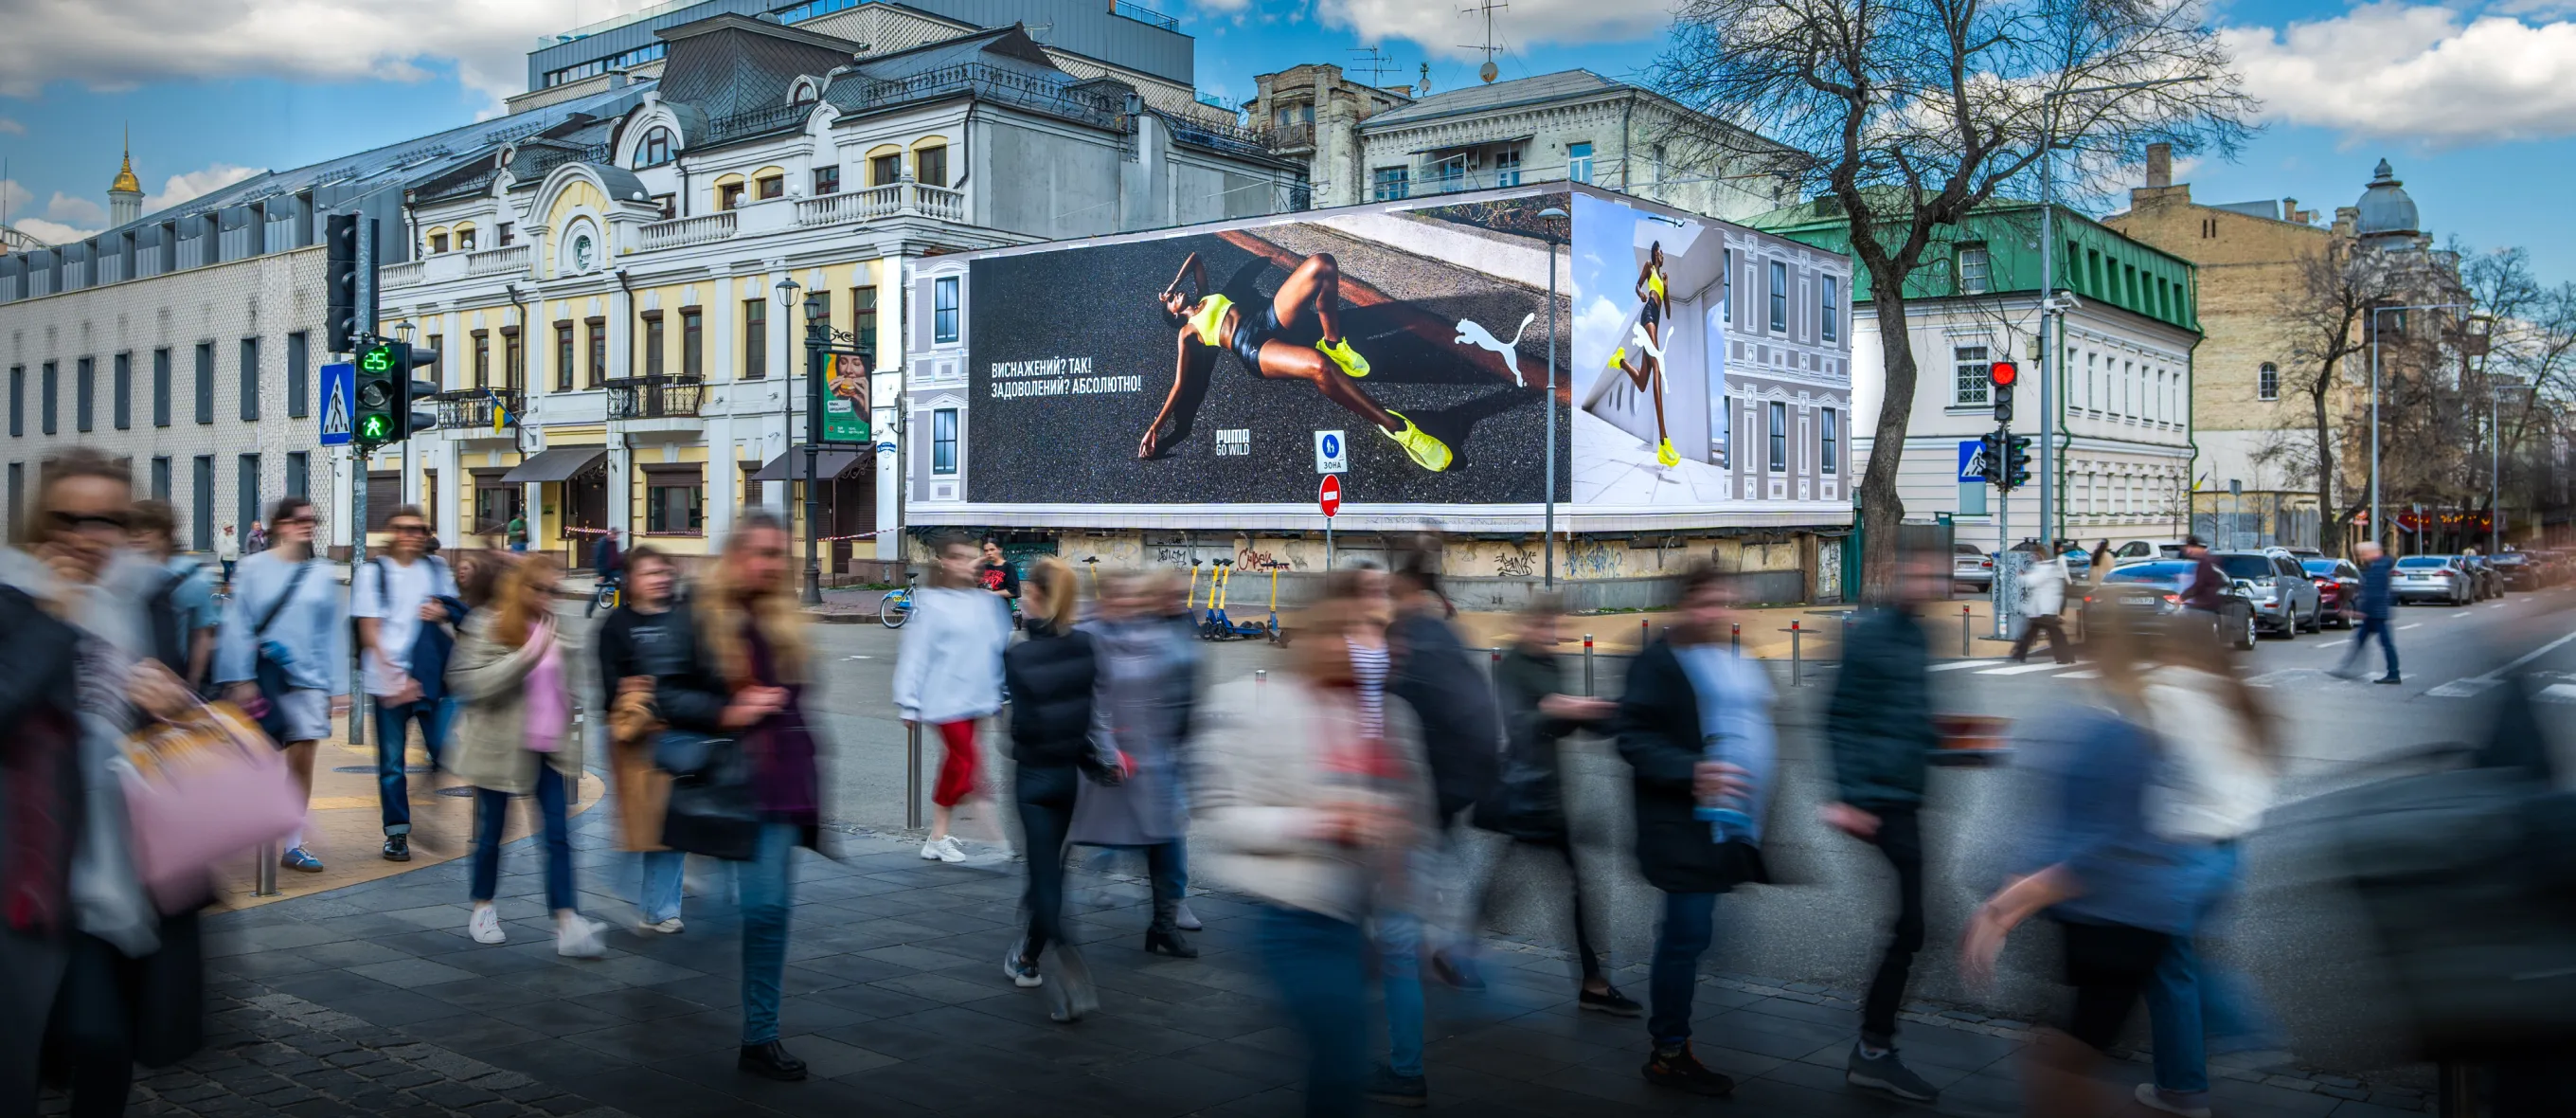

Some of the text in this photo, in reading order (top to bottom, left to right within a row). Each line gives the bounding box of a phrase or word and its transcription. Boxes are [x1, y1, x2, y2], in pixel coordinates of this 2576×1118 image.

[365, 352, 386, 370] 25
[992, 355, 1092, 378] ВИСНАЖЕНИЙ? ТАК!
[991, 374, 1141, 400] ЗАДОВОЛЕНИЙ? АБСОЛЮТНО!
[1216, 429, 1250, 443] PUMA
[1216, 443, 1250, 456] GO WILD
[1323, 461, 1342, 470] ЗОНА
